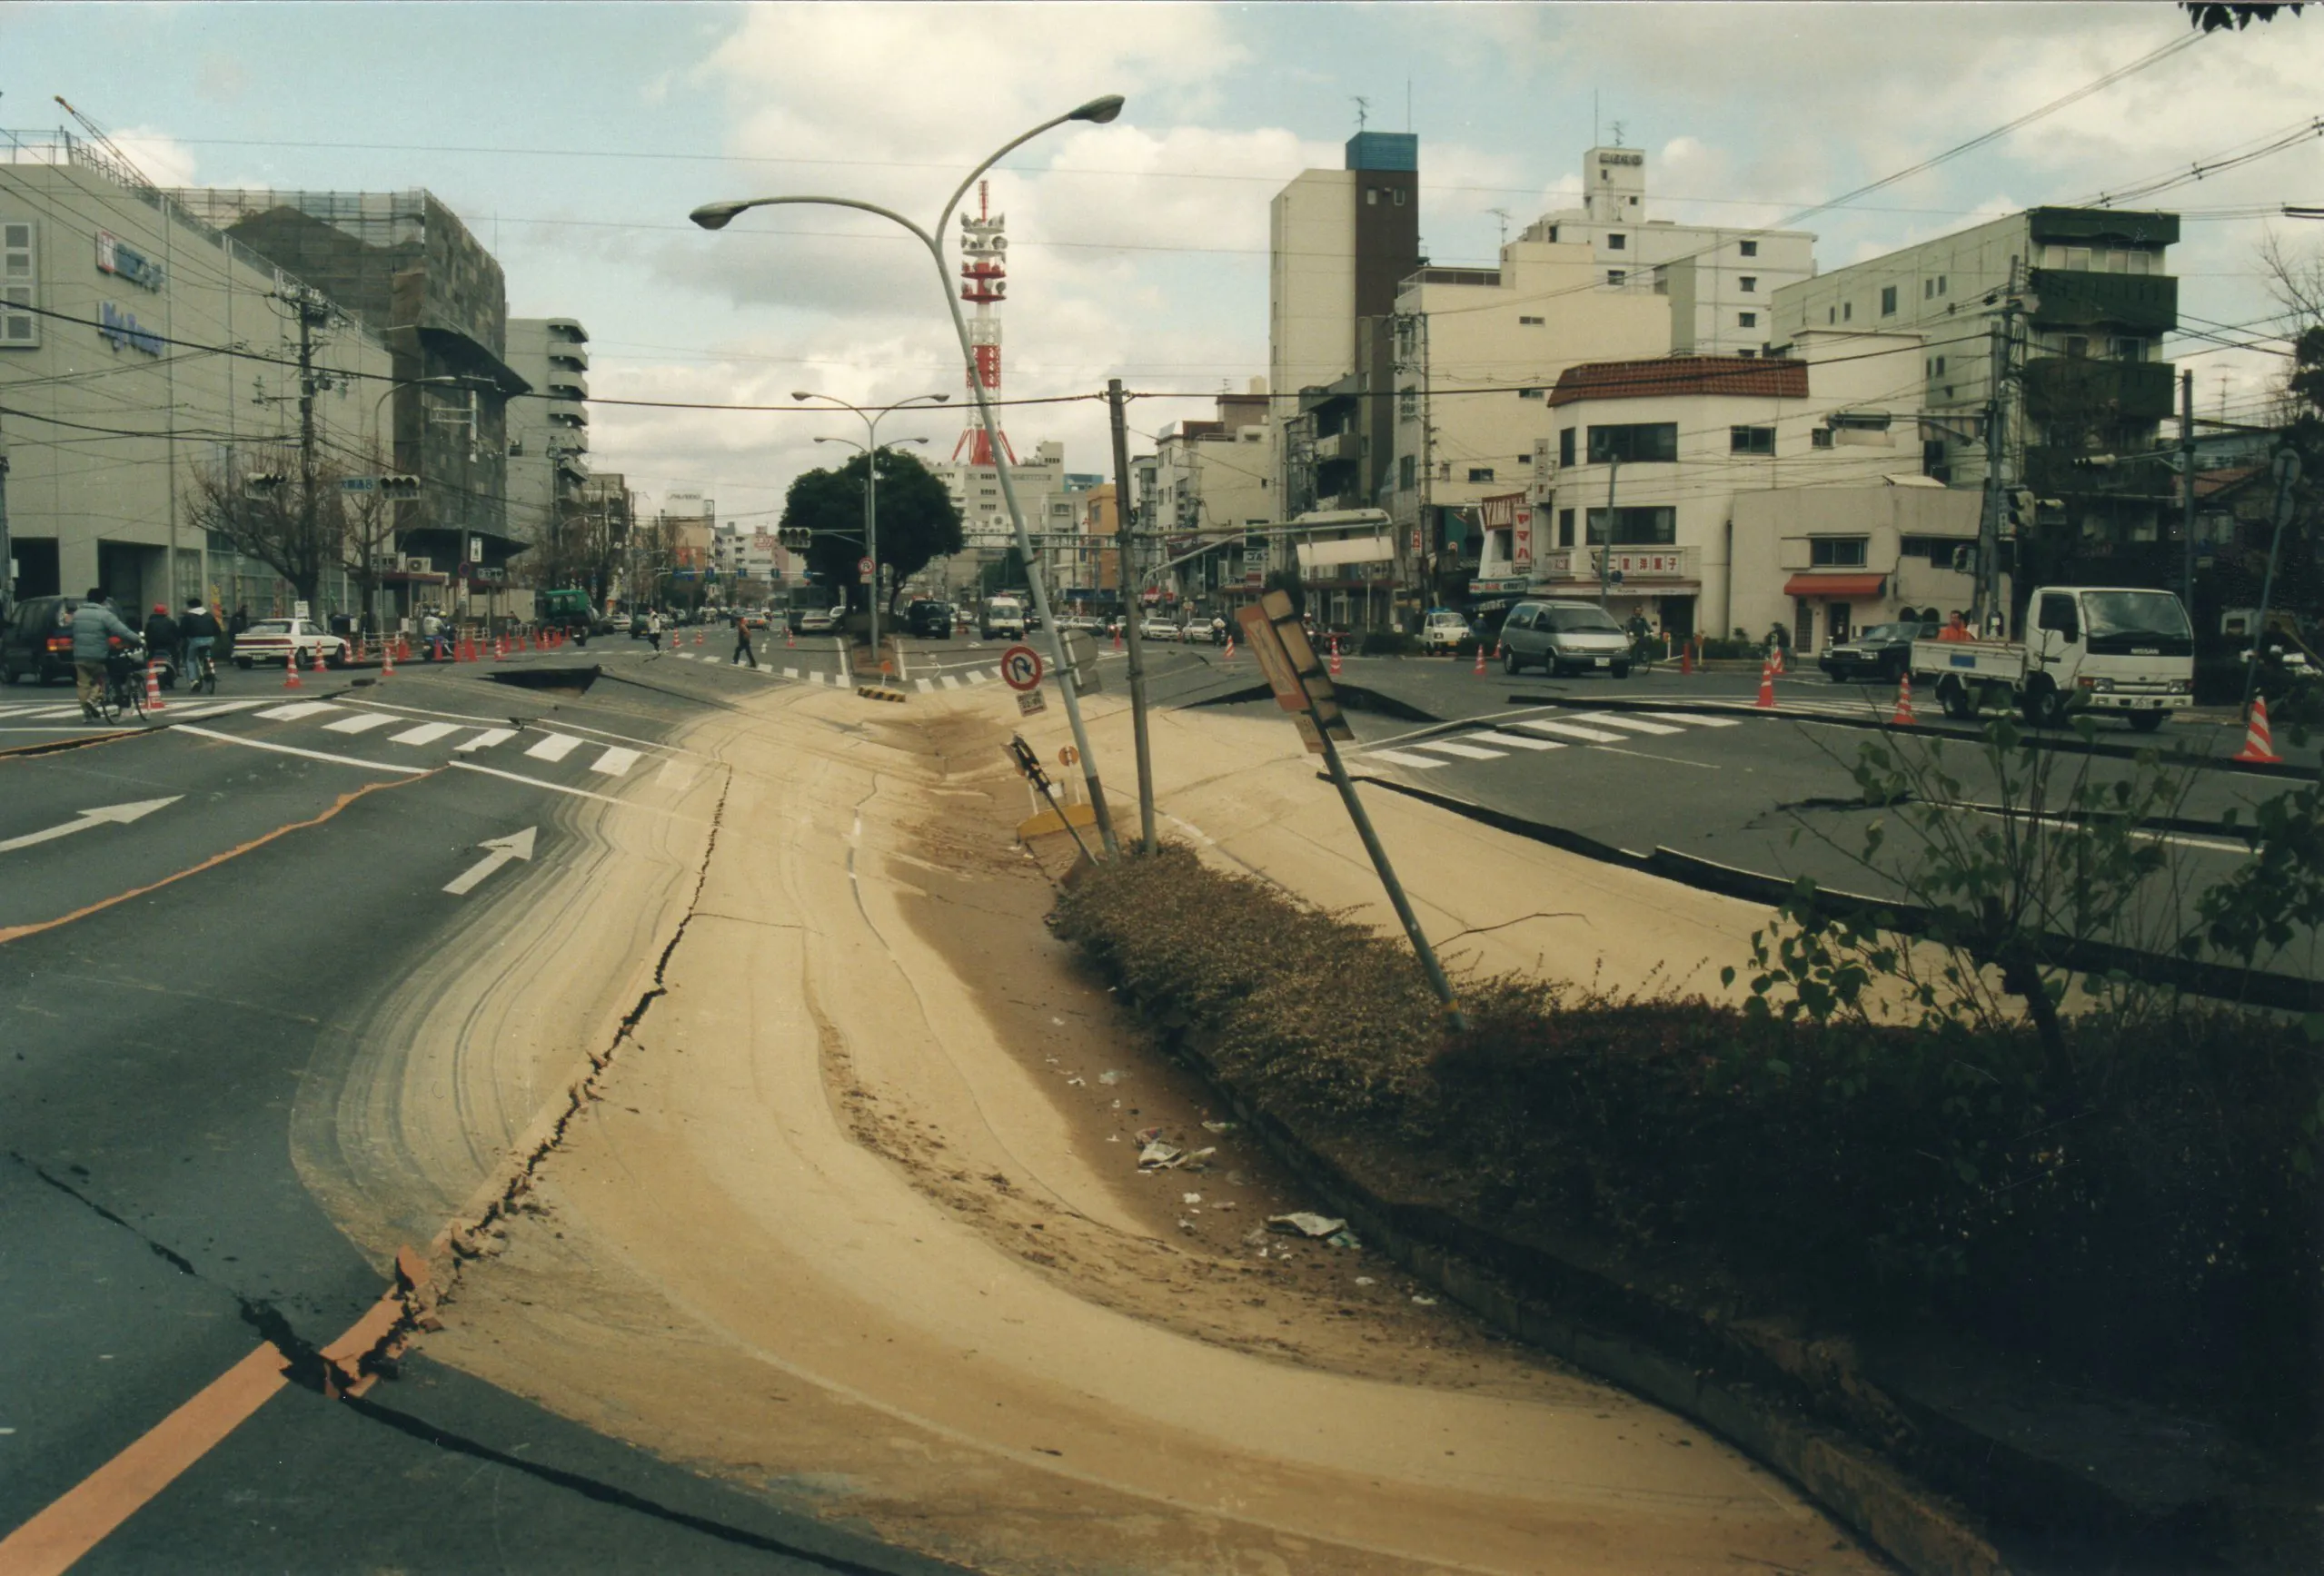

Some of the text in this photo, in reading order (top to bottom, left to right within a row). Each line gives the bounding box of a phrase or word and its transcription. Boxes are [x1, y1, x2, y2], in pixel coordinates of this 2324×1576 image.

[1516, 513, 1529, 560] ヤマハ
[2130, 647, 2160, 655] NISSAN
